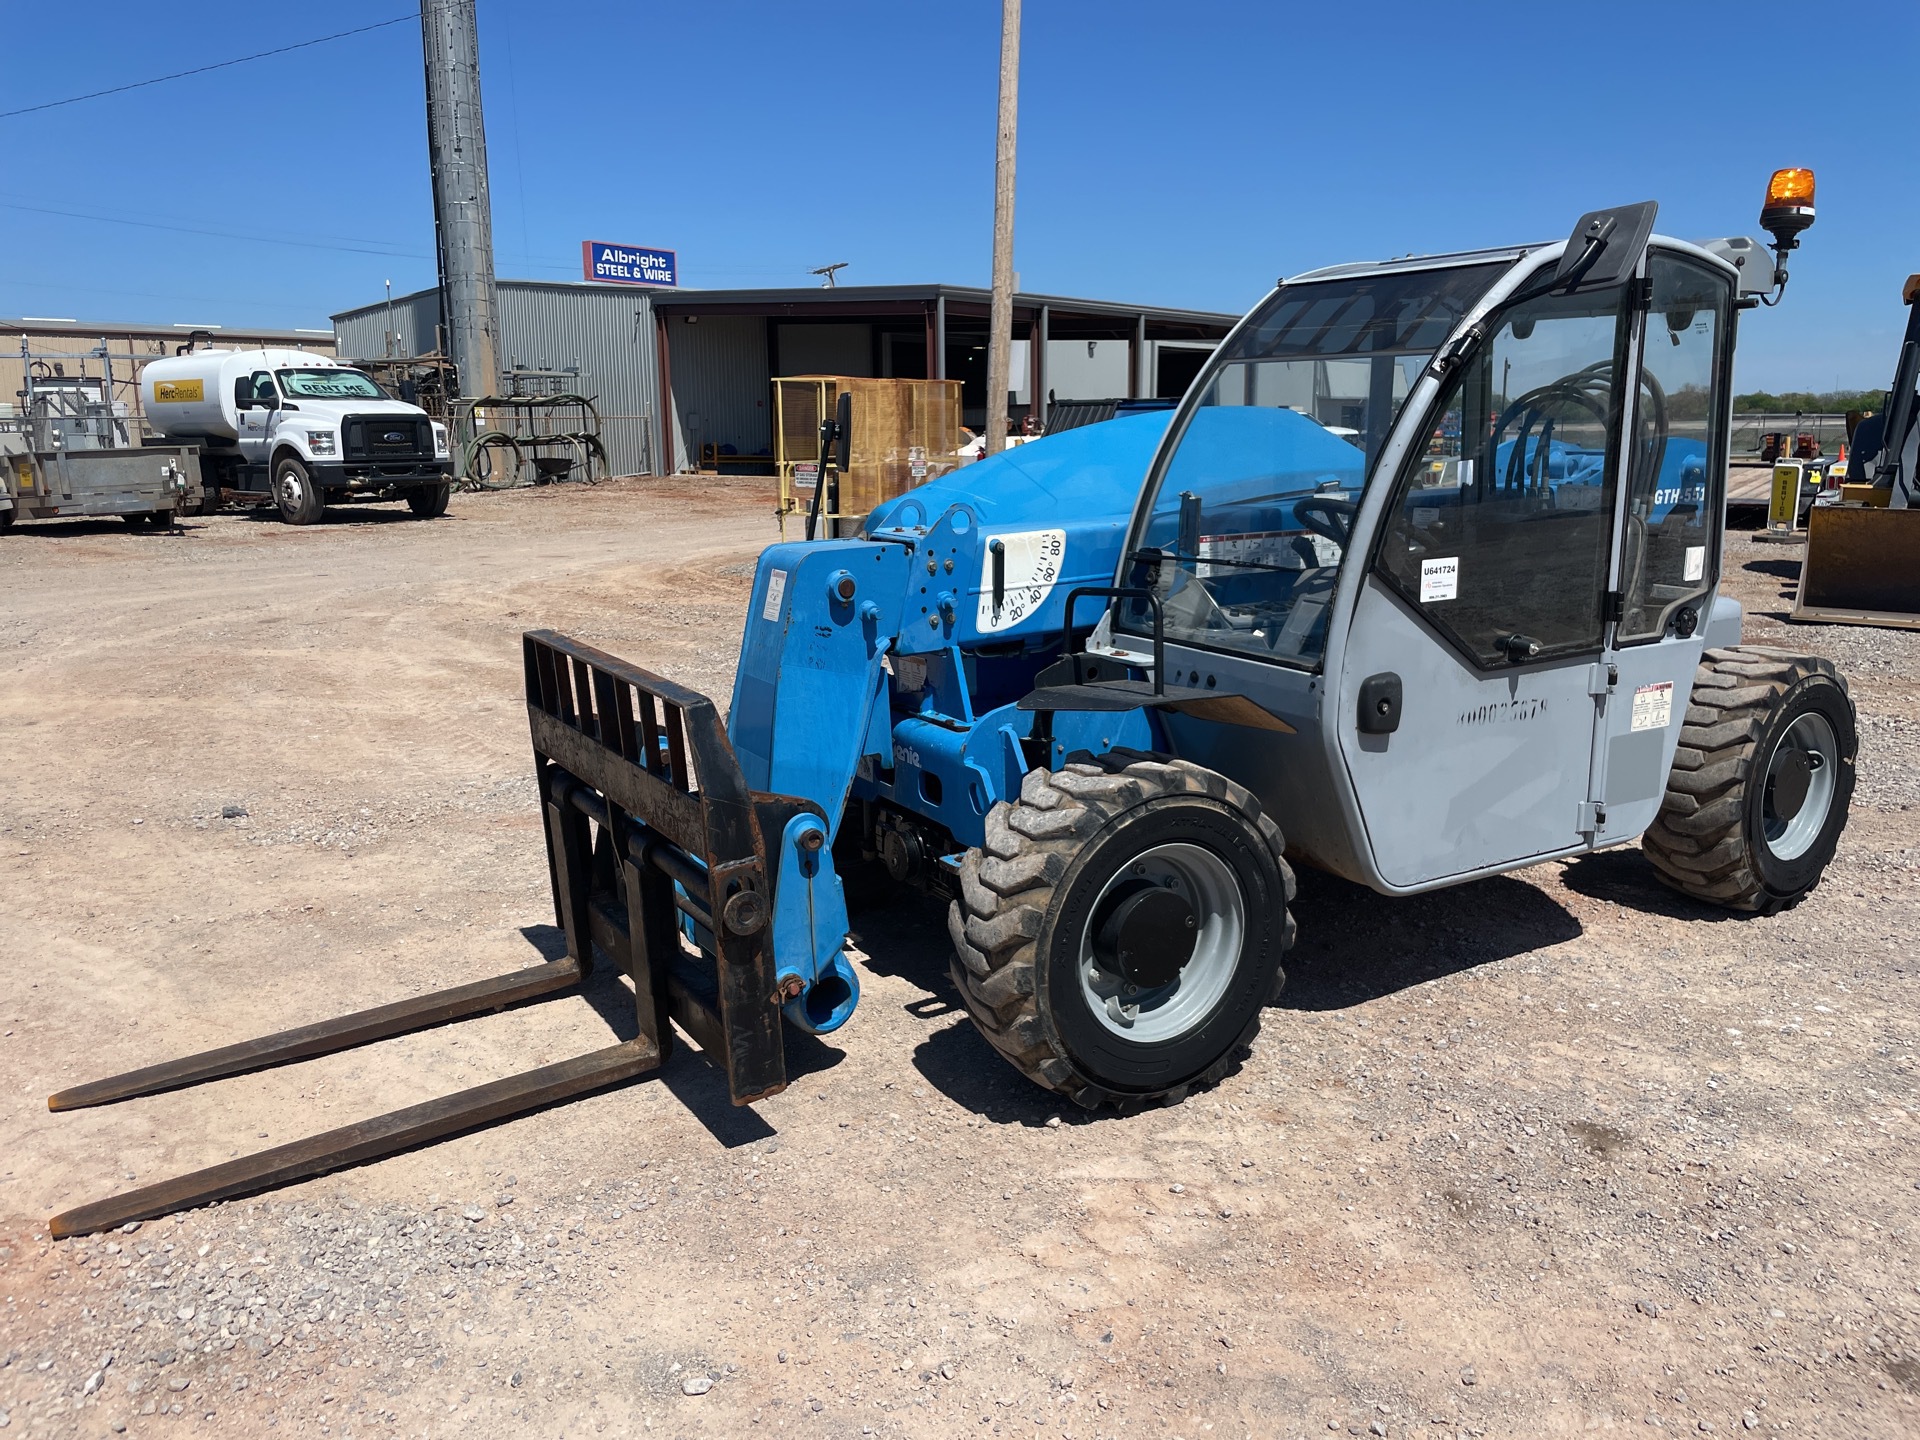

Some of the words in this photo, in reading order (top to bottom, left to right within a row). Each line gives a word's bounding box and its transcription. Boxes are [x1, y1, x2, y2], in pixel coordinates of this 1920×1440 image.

[602, 248, 666, 268] Albright
[596, 263, 631, 278] STEEL
[633, 267, 641, 278] &
[644, 268, 672, 282] WIRE
[160, 387, 198, 399] HercRentals
[301, 384, 341, 392] RENT
[1655, 486, 1705, 505] GTH-551
[1424, 565, 1455, 575] U641724
